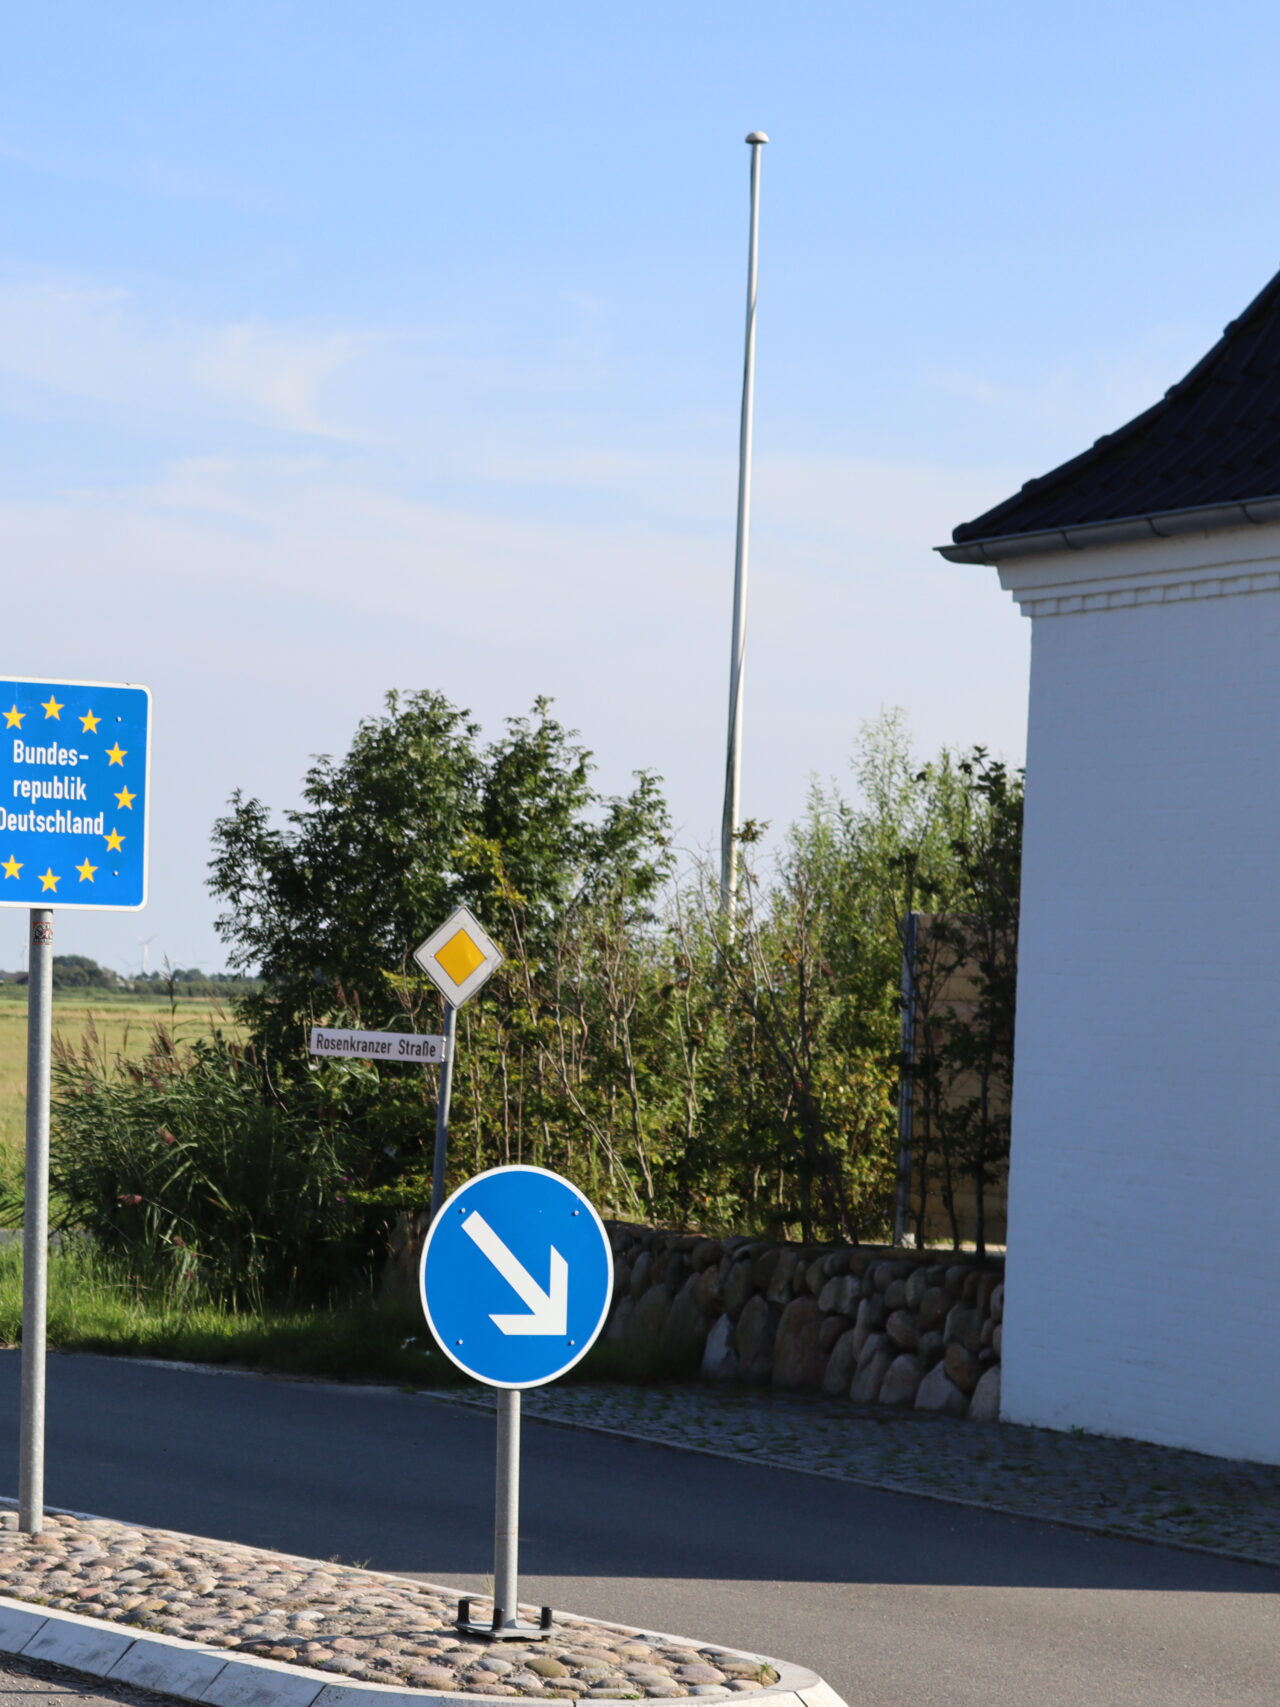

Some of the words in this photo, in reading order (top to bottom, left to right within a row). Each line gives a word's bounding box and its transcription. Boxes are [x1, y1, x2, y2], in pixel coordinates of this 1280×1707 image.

[13, 739, 89, 766] Bundes-
[13, 775, 87, 805] republik
[316, 1033, 392, 1054] Rosenkranzer
[398, 1039, 436, 1057] Straße
